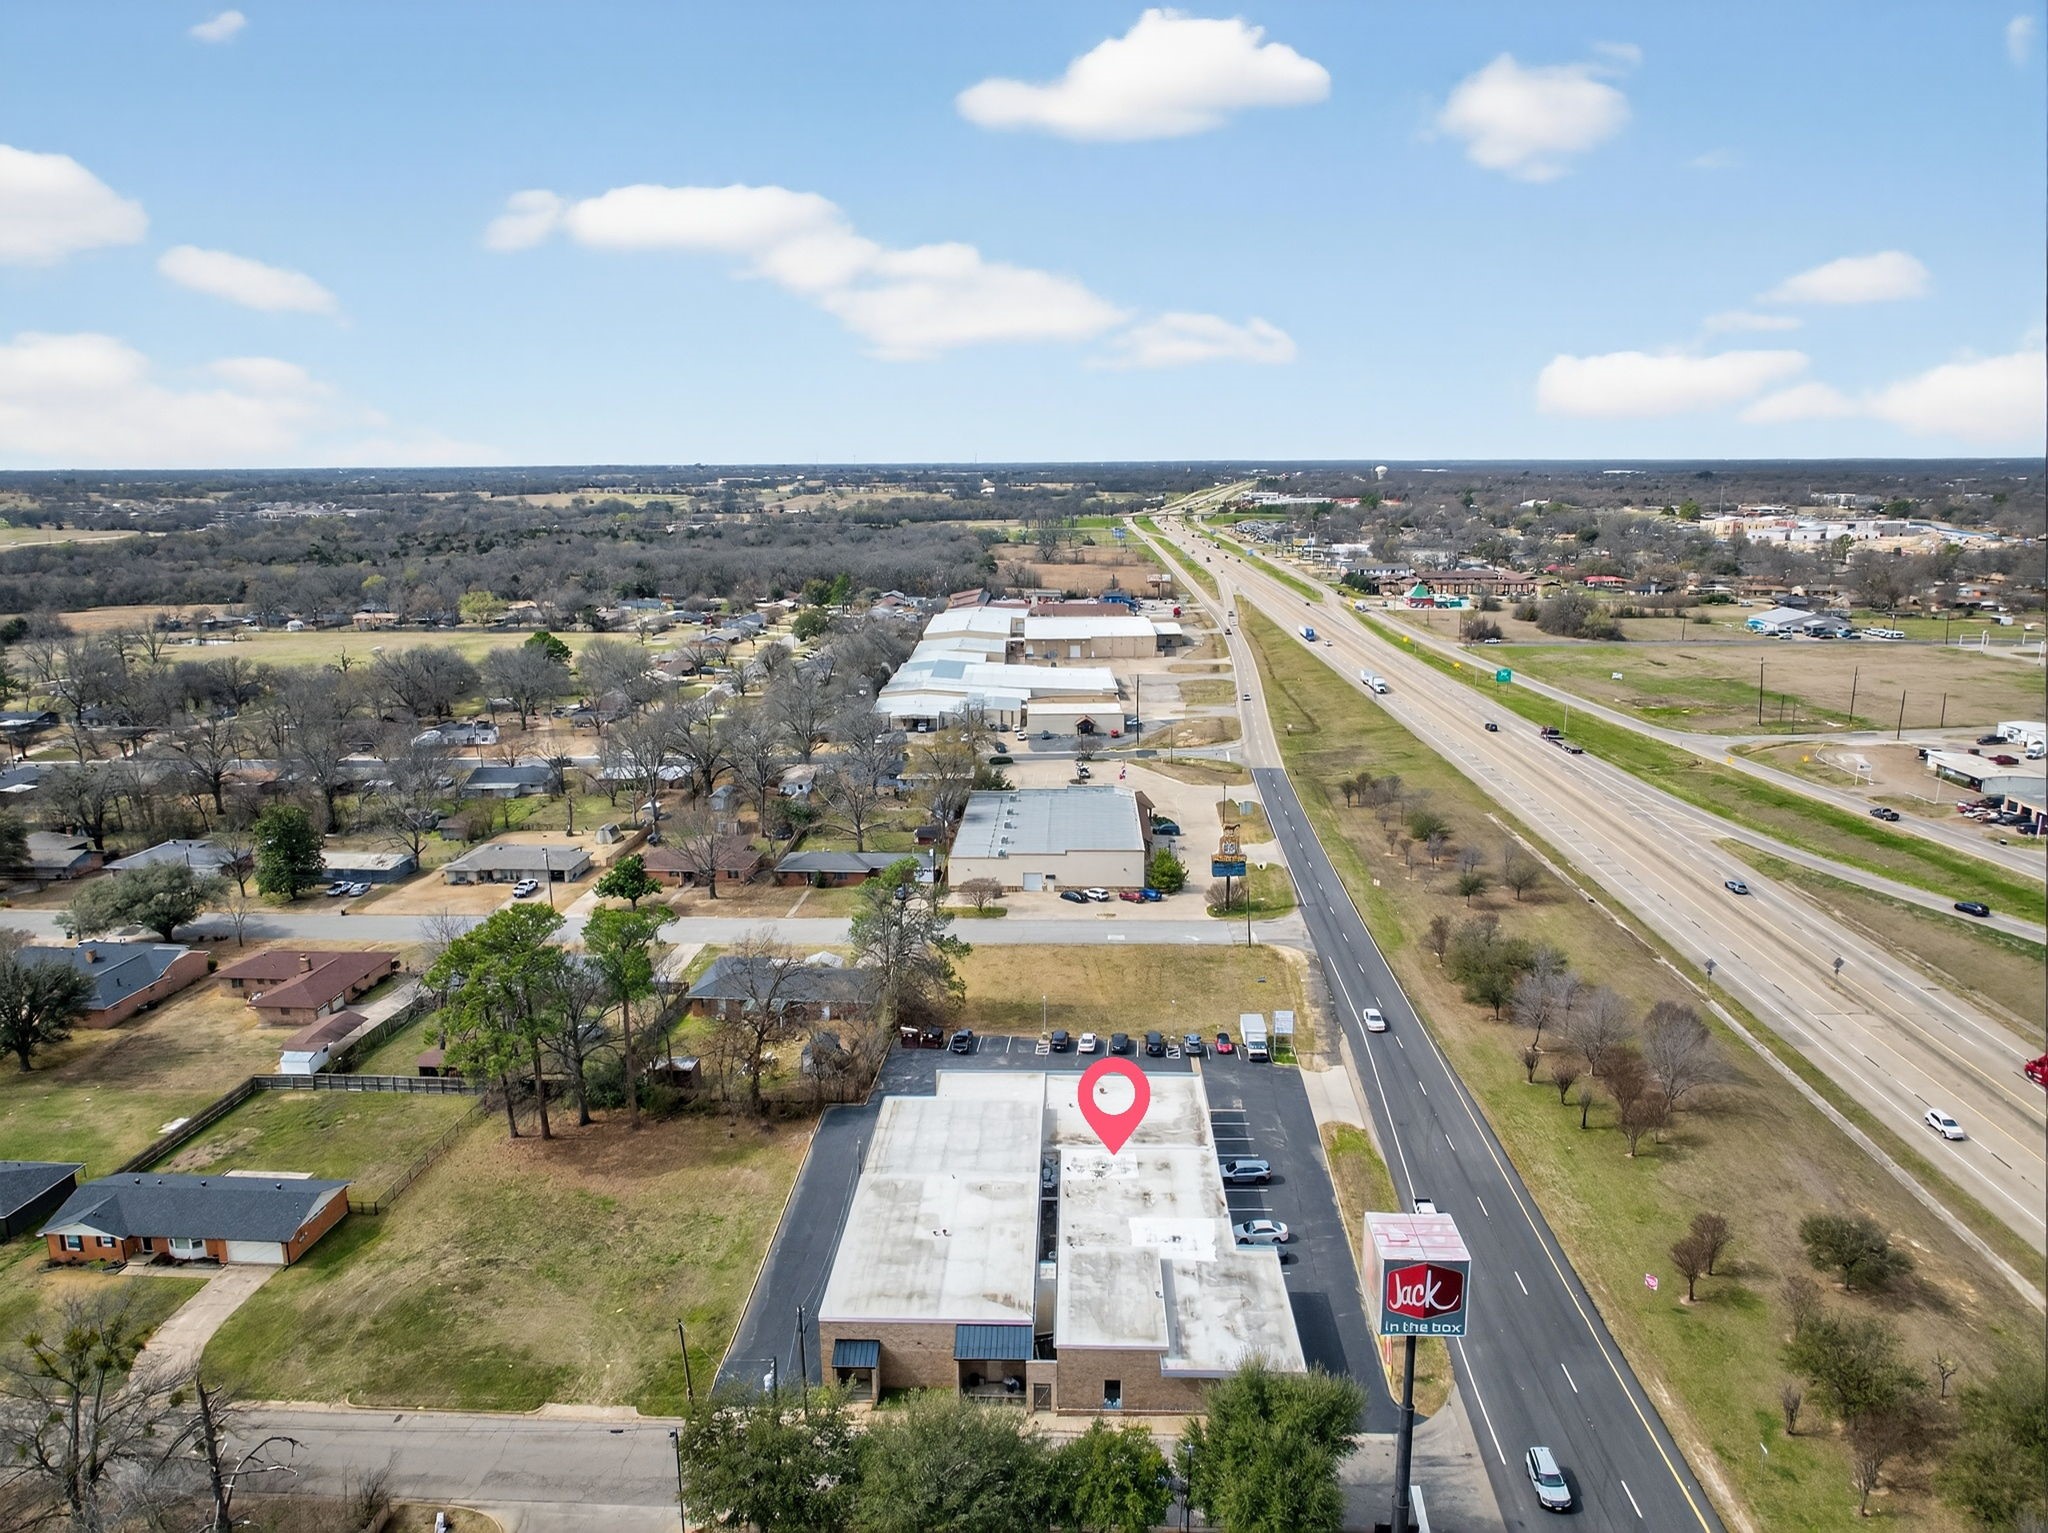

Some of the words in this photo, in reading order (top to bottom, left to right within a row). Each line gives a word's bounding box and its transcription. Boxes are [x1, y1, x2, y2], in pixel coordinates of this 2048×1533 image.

[1389, 1269, 1459, 1310] Jack
[1385, 1320, 1399, 1332] in
[1403, 1321, 1428, 1333] the
[1432, 1322, 1462, 1333] box
